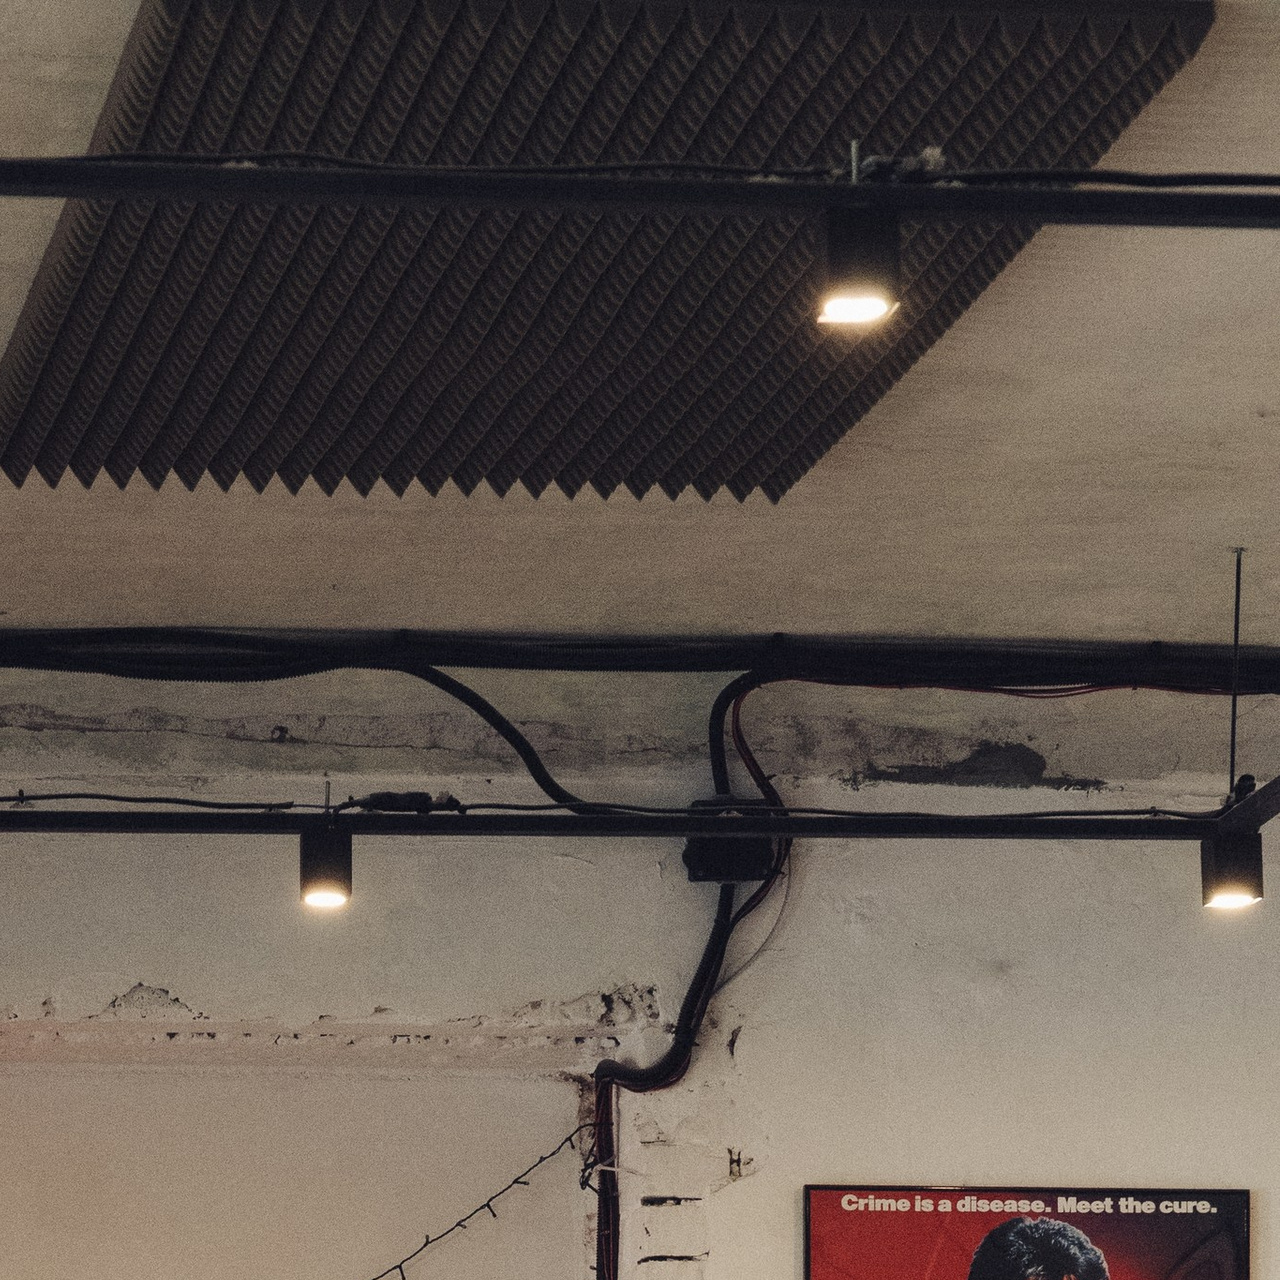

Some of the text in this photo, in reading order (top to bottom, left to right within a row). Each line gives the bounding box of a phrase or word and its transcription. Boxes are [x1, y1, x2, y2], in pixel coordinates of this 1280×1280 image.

[840, 1194, 1218, 1213] Crime is a disease. Meet the cure.
